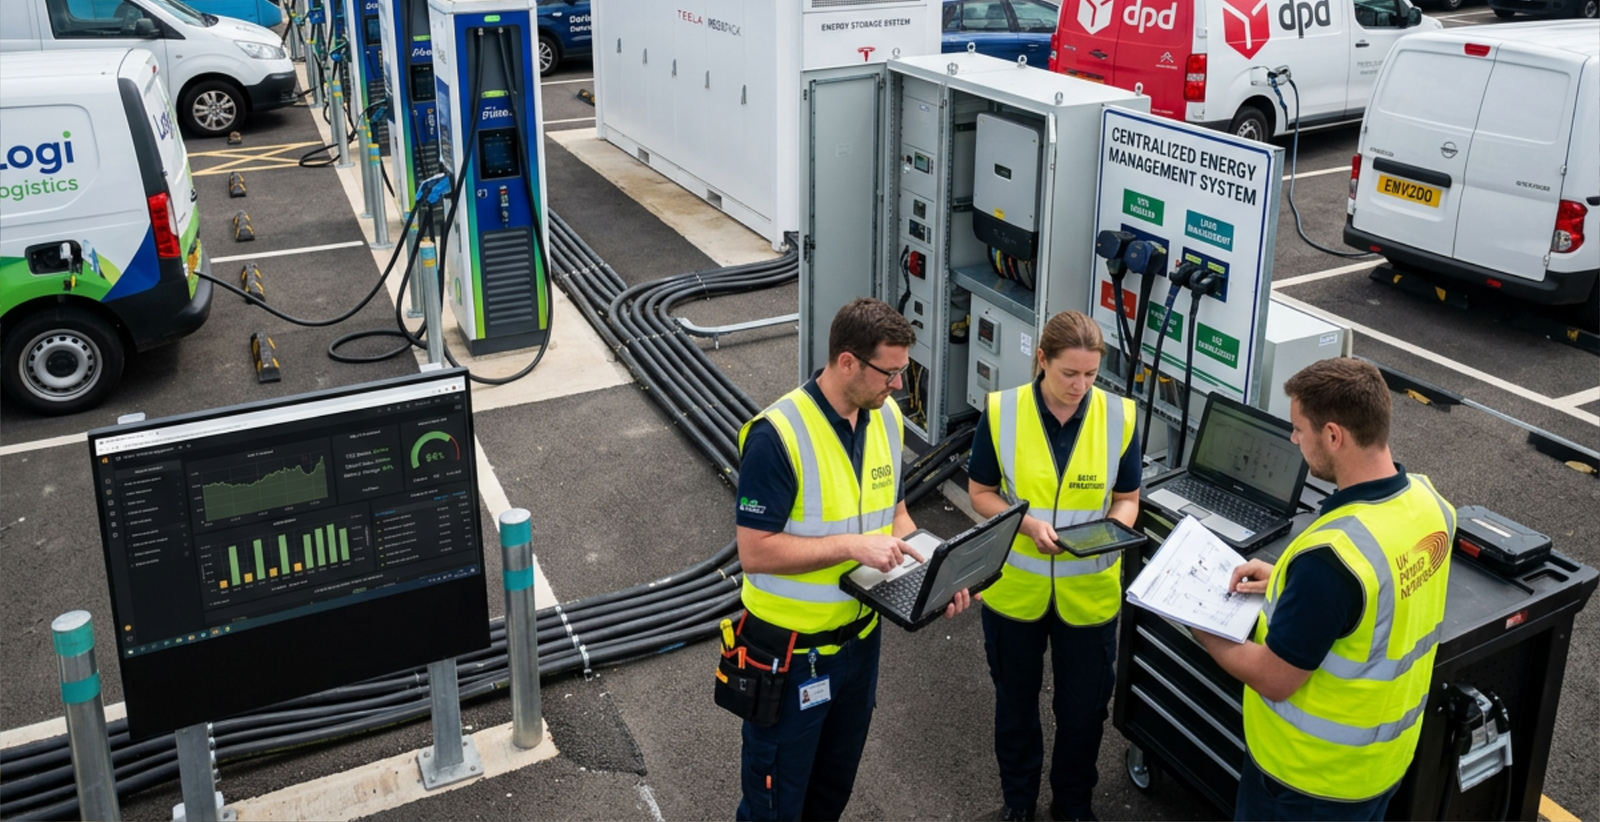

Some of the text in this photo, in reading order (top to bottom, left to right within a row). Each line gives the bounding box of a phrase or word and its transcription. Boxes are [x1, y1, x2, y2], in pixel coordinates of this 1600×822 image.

[1123, 0, 1178, 34] dpd
[1278, 0, 1332, 39] dpd
[0, 131, 74, 175] ogi
[1112, 127, 1257, 182] CENTRALIZED ENERGY
[0, 177, 79, 202] ogistics
[1108, 147, 1257, 206] MANAGEMENT SYSTEM
